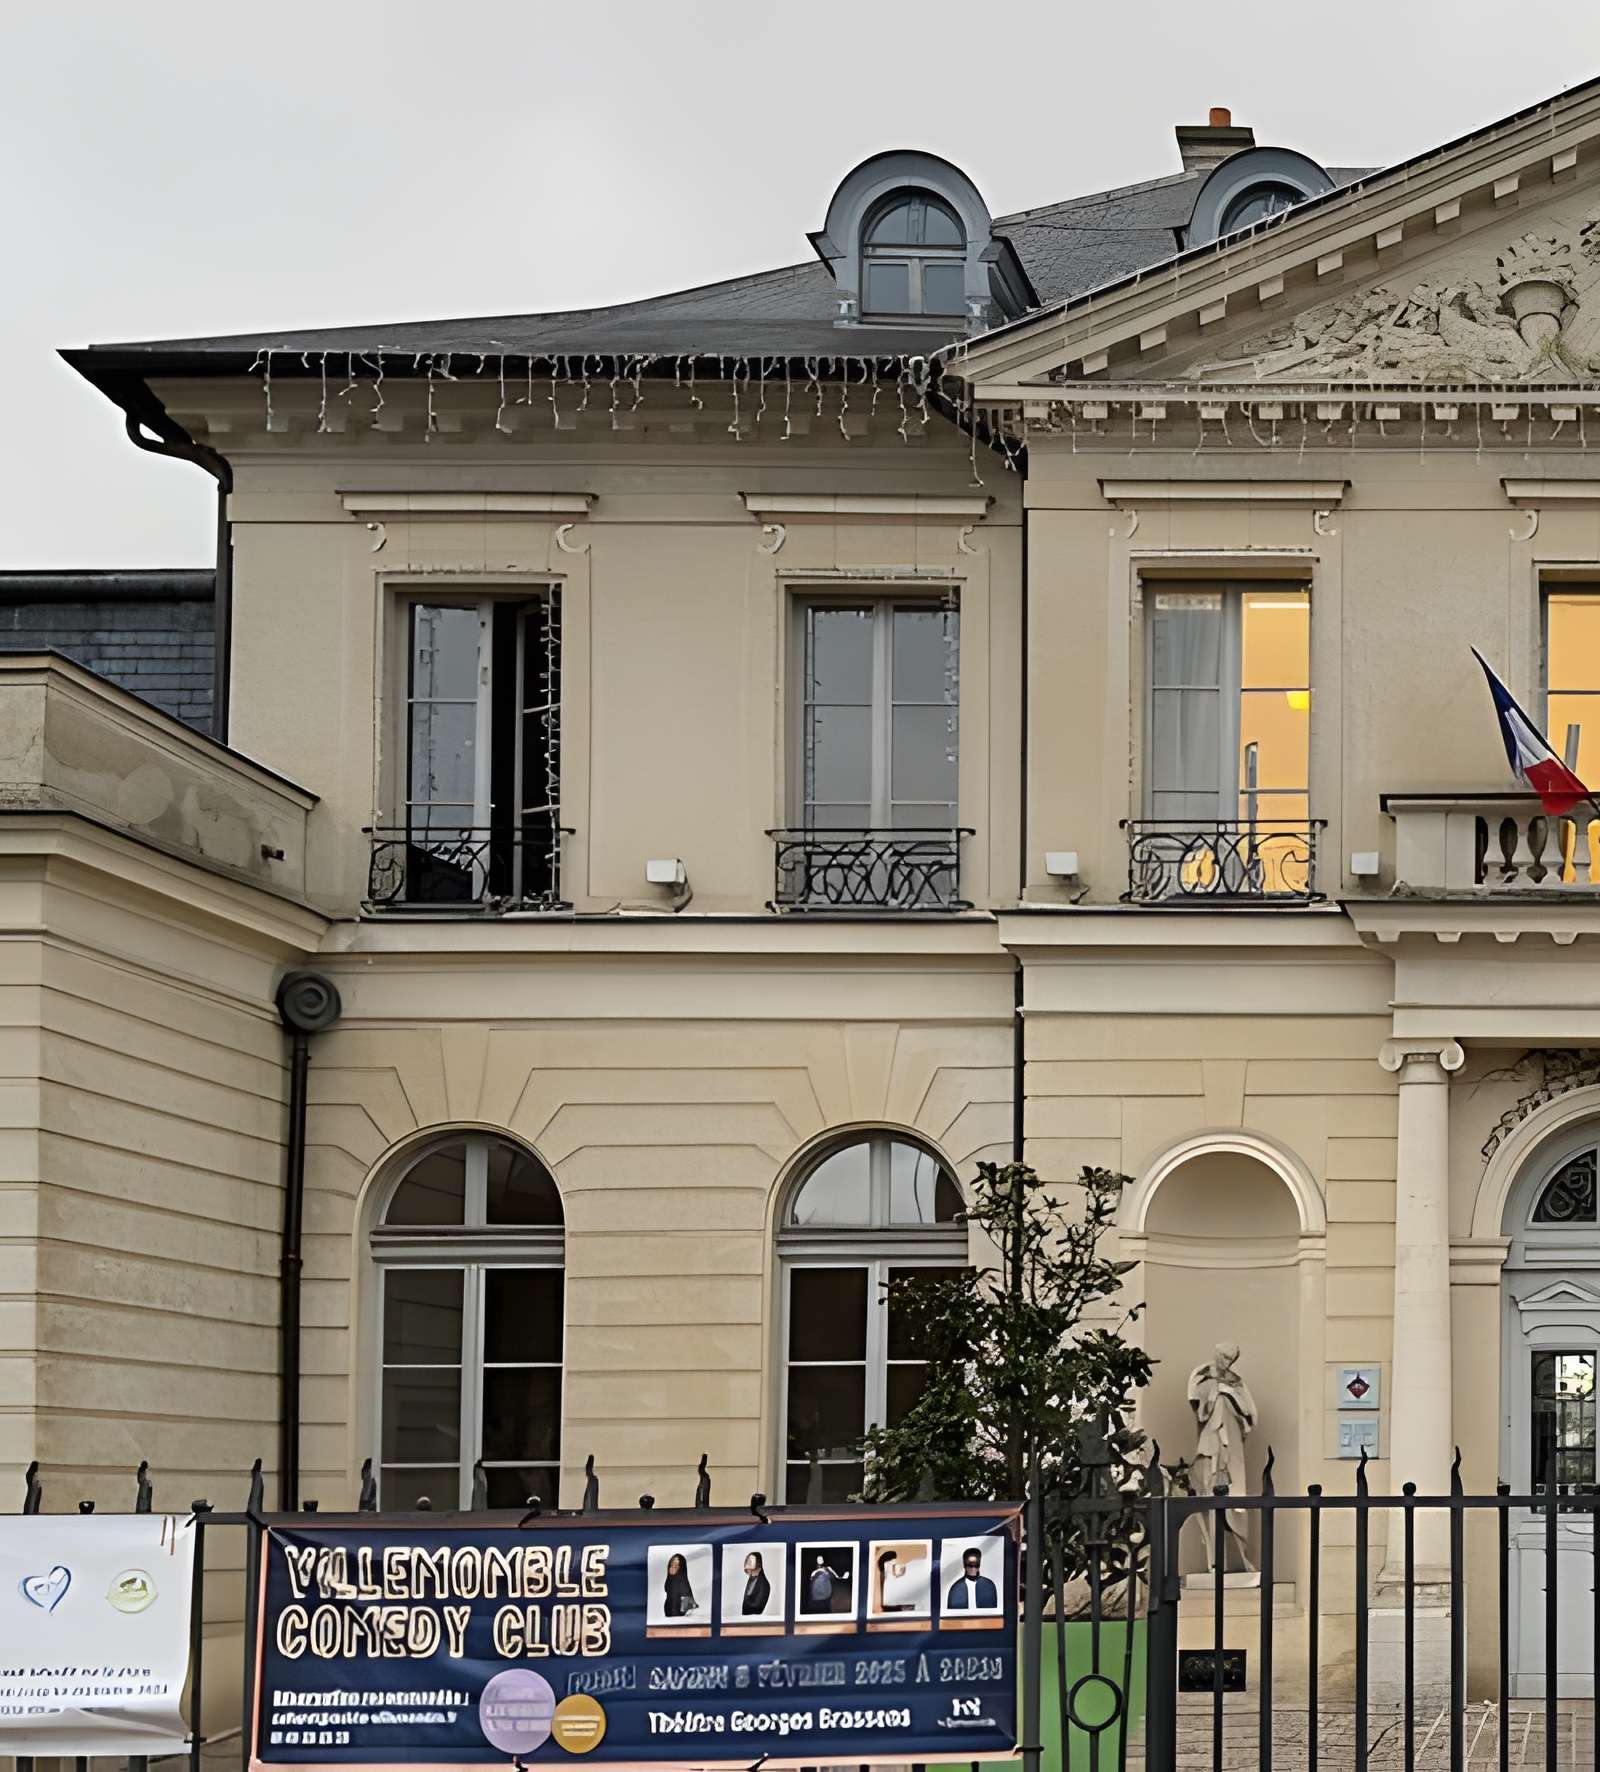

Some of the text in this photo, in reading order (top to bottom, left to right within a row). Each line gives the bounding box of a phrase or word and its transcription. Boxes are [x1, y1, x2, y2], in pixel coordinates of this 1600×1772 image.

[284, 1544, 611, 1600] VILLEMOMBLE
[276, 1603, 613, 1659] COMEDY CLUB
[855, 1659, 906, 1685] 2025
